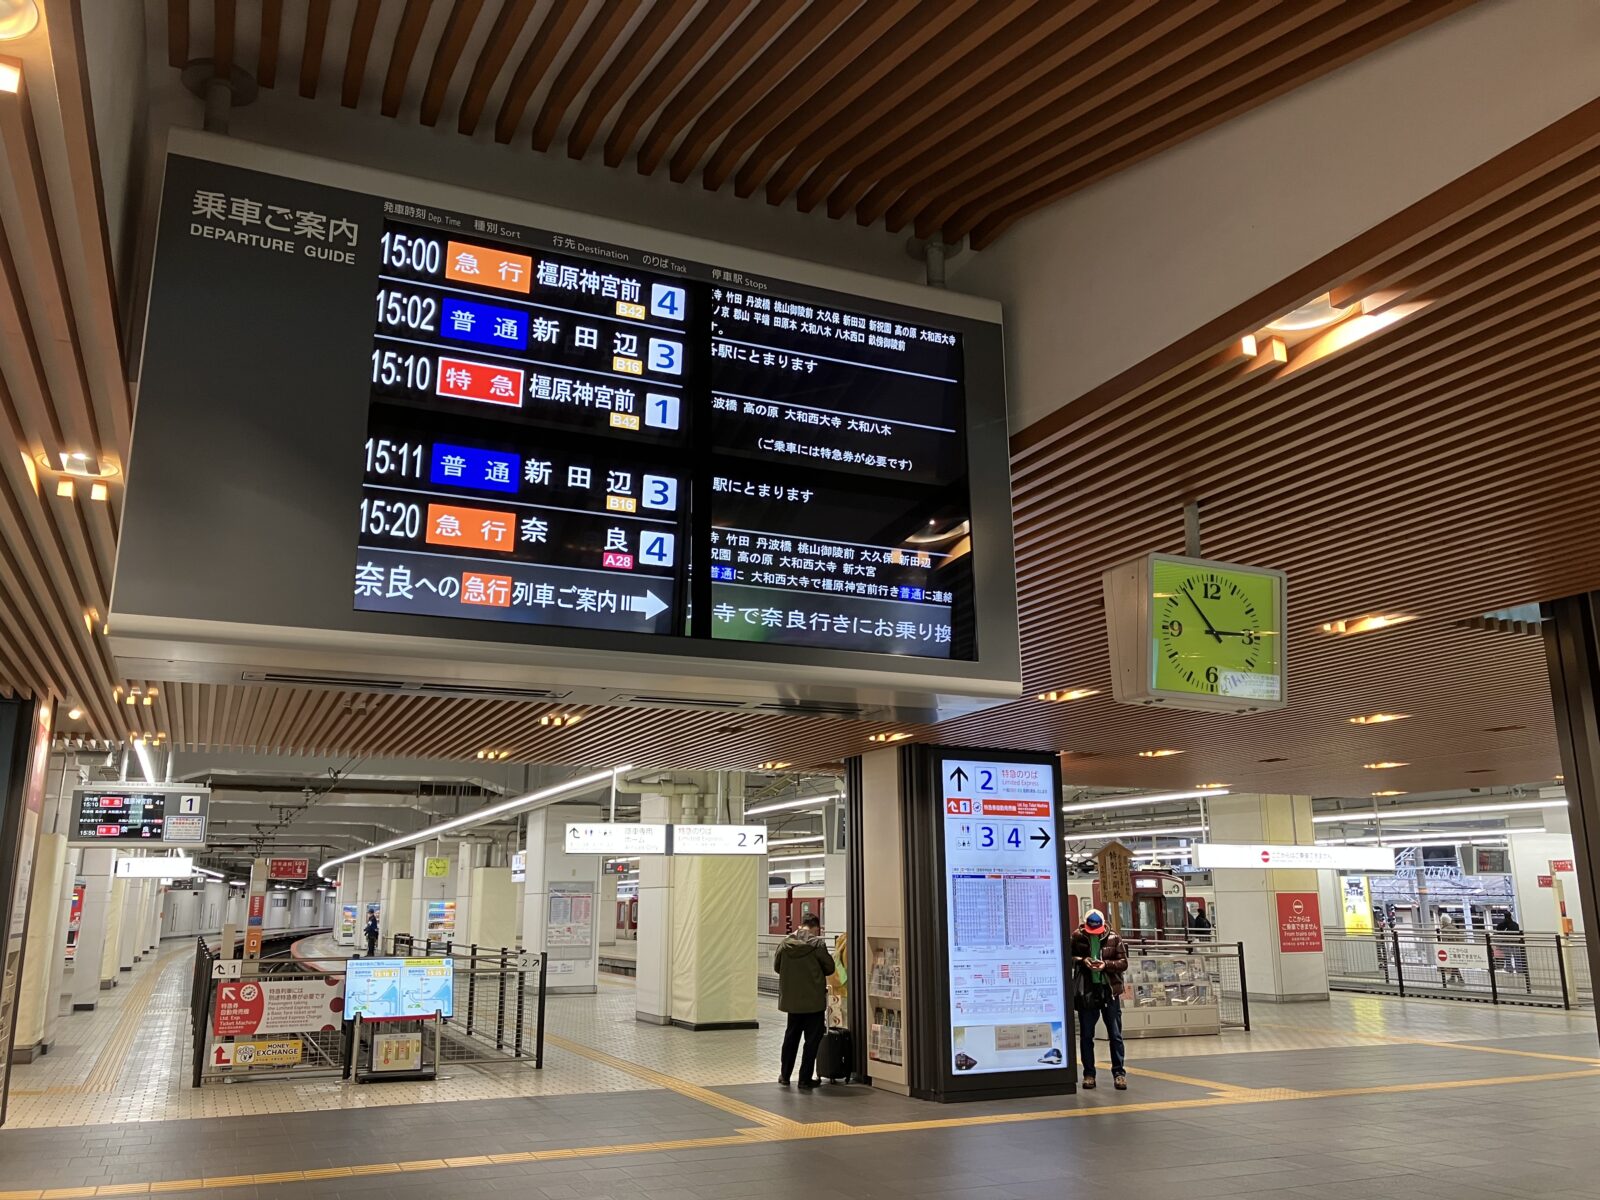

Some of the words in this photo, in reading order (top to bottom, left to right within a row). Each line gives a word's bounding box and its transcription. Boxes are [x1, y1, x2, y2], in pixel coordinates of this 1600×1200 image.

[192, 190, 359, 247] 乗車ご案内
[383, 201, 427, 220] 発車時刻
[445, 215, 462, 227] Time
[474, 219, 498, 234] 種別
[500, 227, 521, 239] Sort
[190, 223, 295, 254] DEPARTURE
[304, 245, 356, 265] GUIDE
[552, 235, 576, 250] 行先
[577, 242, 629, 262] Destination
[380, 231, 440, 274] 15:00
[536, 260, 641, 302] 橿原神宮前
[657, 290, 679, 315] 4
[642, 254, 669, 269] のりば
[670, 262, 687, 273] Track
[712, 268, 743, 285] 停車駅
[745, 277, 768, 291] Stops
[618, 303, 643, 318] B42
[726, 291, 742, 305] 竹田
[816, 309, 840, 325] 大久保
[843, 314, 866, 330] 新田辺
[920, 329, 956, 347] 大和西大寺
[376, 289, 435, 331] 15:02
[655, 344, 675, 369] 3
[773, 316, 798, 331] 田原本
[800, 322, 832, 337] 大和八木
[834, 328, 865, 343] 八木西口
[616, 358, 641, 373] B16
[371, 349, 430, 391] 15:10
[529, 373, 635, 413] 橿原神宮前
[654, 399, 668, 424] 1
[612, 413, 638, 428] B42
[743, 402, 779, 418] 高の原
[784, 409, 842, 429] 大和西大寺
[847, 418, 892, 436] 大和八木
[365, 437, 423, 478] 15:11
[650, 480, 670, 506] 3
[713, 477, 814, 503] 駅にとまります
[608, 497, 634, 511] B16
[360, 498, 420, 539] 15:20
[646, 536, 668, 562] 4
[605, 554, 631, 568] A28
[726, 533, 750, 547] 竹田
[756, 537, 792, 553] 丹波橋
[797, 541, 855, 560] 桃山御陵前
[860, 550, 894, 564] 大久保
[900, 554, 931, 569] 新田辺
[737, 551, 774, 566] 高の原
[779, 556, 837, 573] 大和西大寺
[843, 562, 877, 577] 新大宮
[354, 561, 617, 614] 奈良への急行列車ご案内
[1203, 583, 1221, 601] 12
[1169, 620, 1183, 637] 9
[1241, 629, 1254, 646] 3
[1205, 666, 1219, 684] 6
[980, 770, 994, 791] 2
[185, 798, 193, 812] 1
[962, 802, 967, 812] 1
[737, 833, 747, 847] 2
[981, 826, 994, 848] 3
[1007, 828, 1021, 848] 4
[231, 964, 236, 973] 1
[521, 958, 528, 967] 2
[256, 1048, 299, 1056] EXCHANGE
